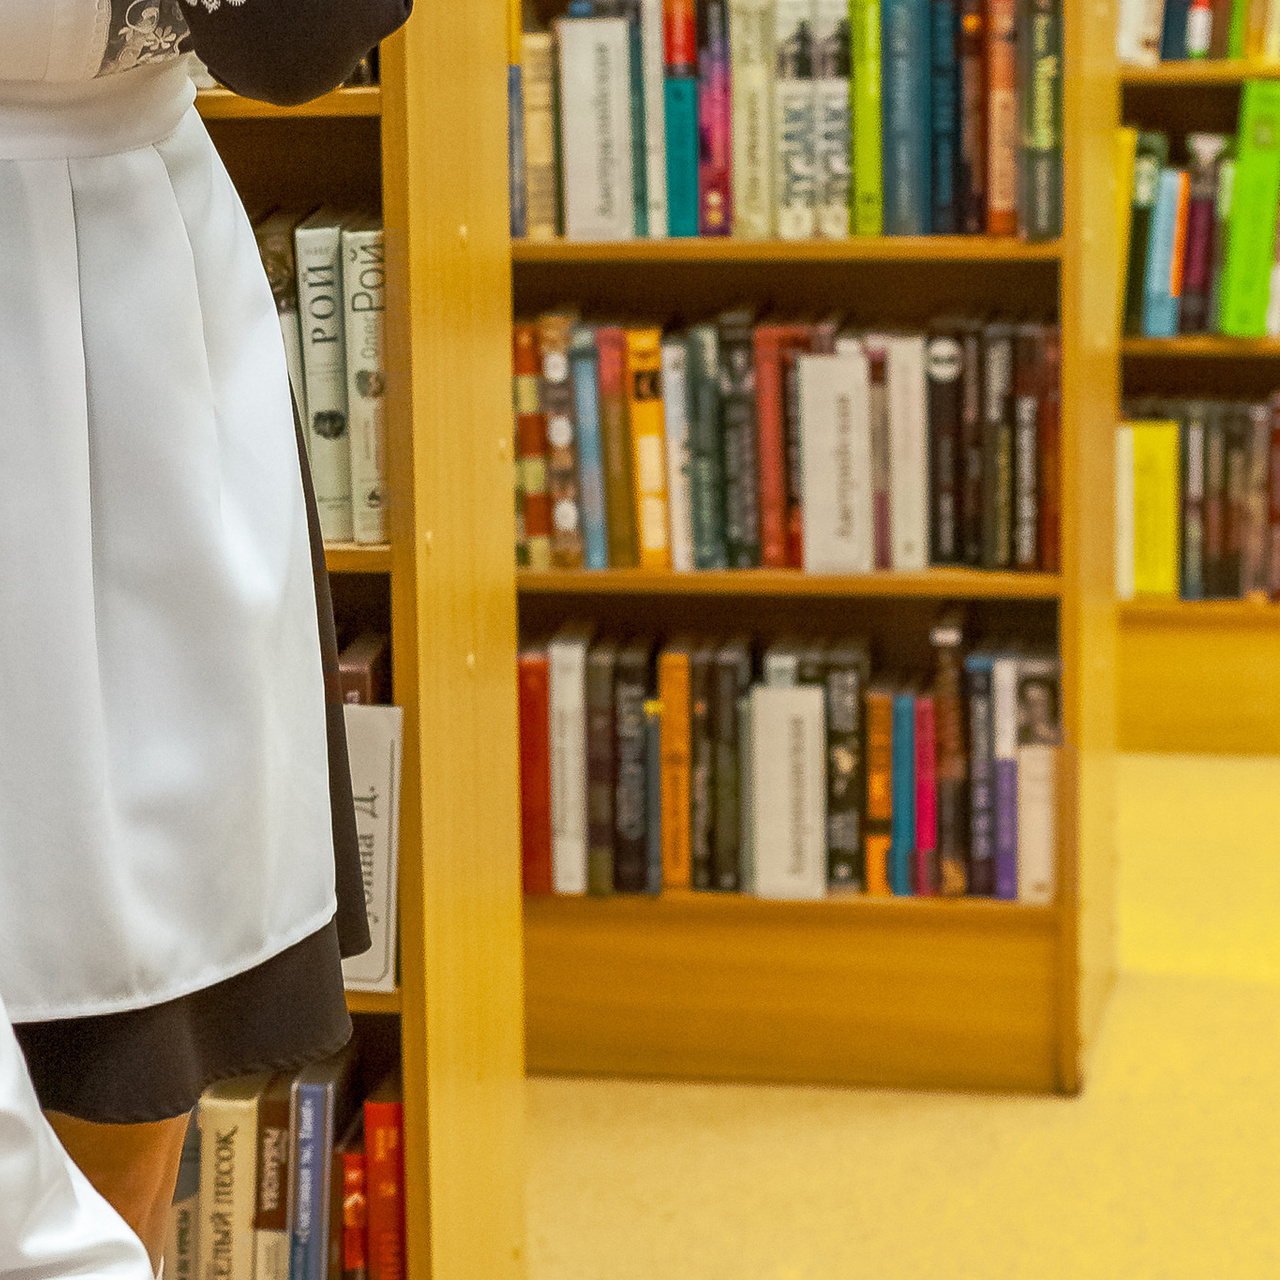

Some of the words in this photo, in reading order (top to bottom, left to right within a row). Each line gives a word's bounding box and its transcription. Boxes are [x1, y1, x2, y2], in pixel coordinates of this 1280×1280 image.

[305, 263, 339, 345] РОЙ
[349, 242, 386, 313] Рой
[212, 1126, 238, 1205] ПЕСОК
